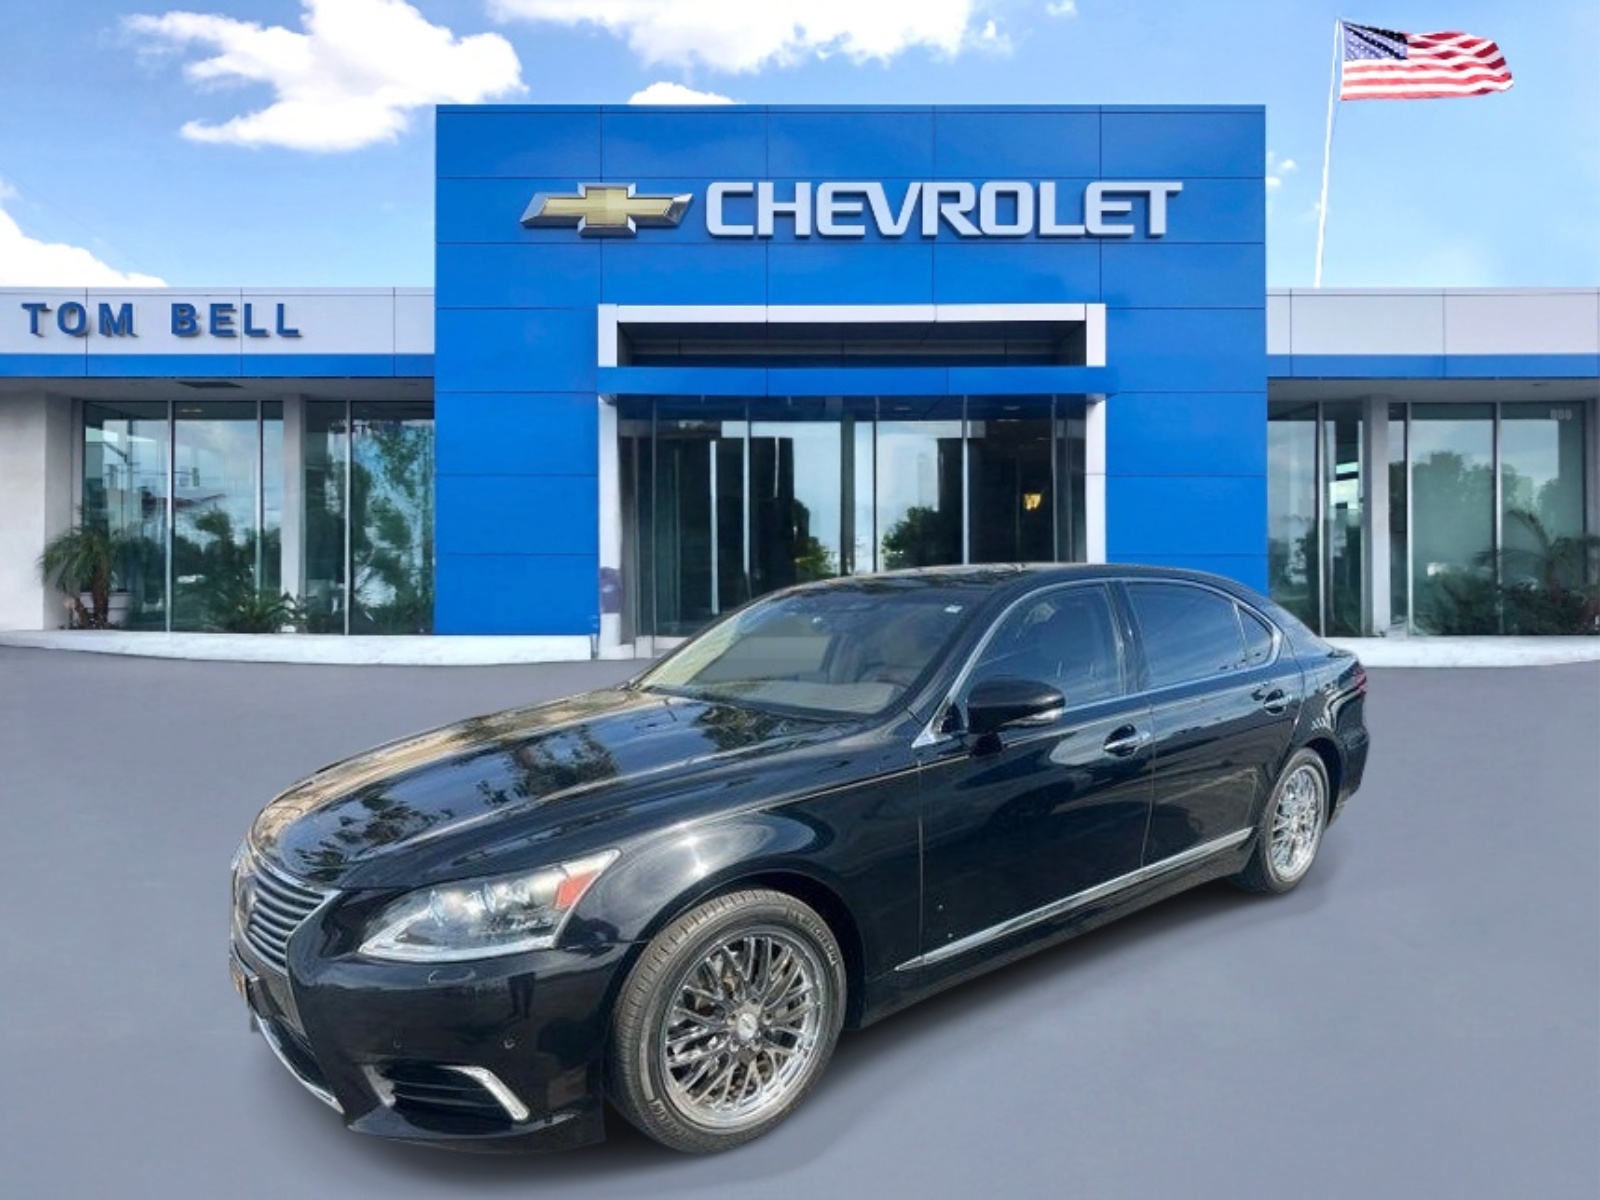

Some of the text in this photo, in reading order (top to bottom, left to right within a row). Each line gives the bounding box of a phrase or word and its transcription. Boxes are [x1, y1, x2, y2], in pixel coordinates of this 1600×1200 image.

[705, 180, 1183, 238] CHEVROLET
[21, 301, 302, 337] TOM BELL
